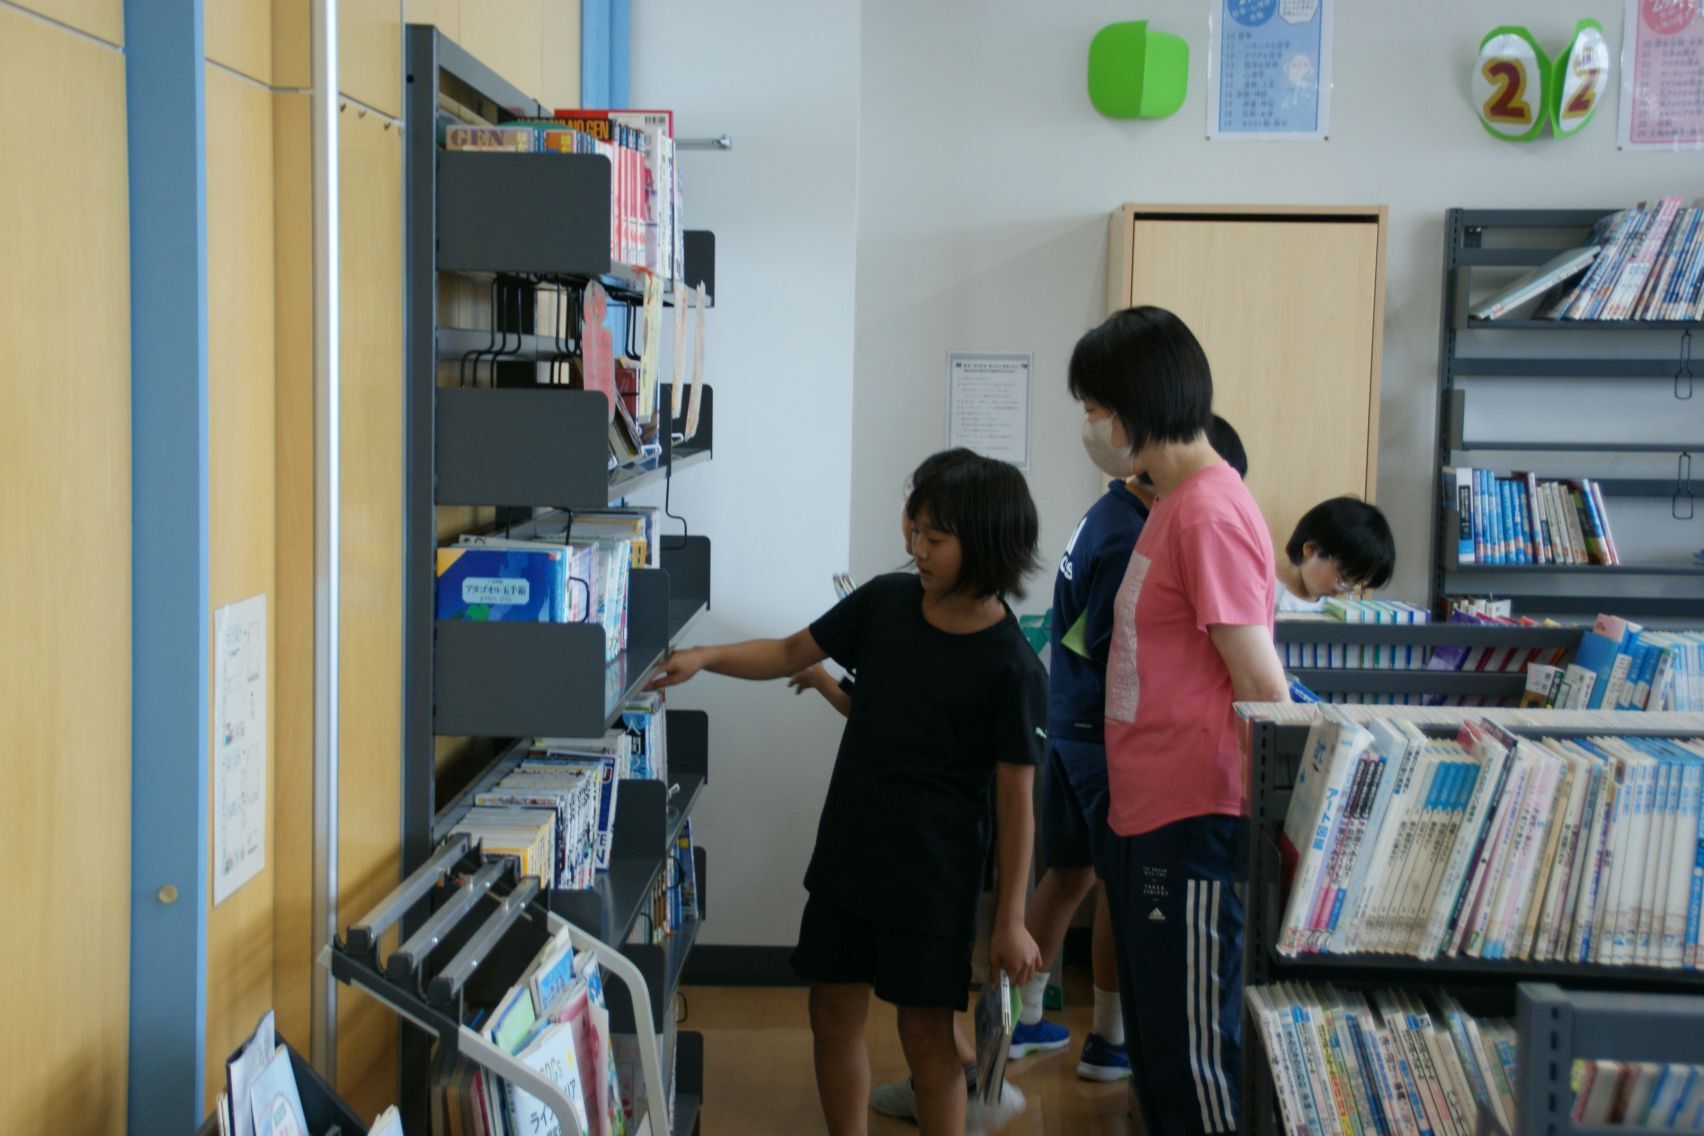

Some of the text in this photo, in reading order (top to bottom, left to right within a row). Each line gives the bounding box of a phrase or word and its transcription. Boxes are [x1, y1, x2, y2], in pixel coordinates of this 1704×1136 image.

[1482, 57, 1532, 125] 2
[450, 128, 505, 147] GEN
[586, 119, 609, 139] GEN
